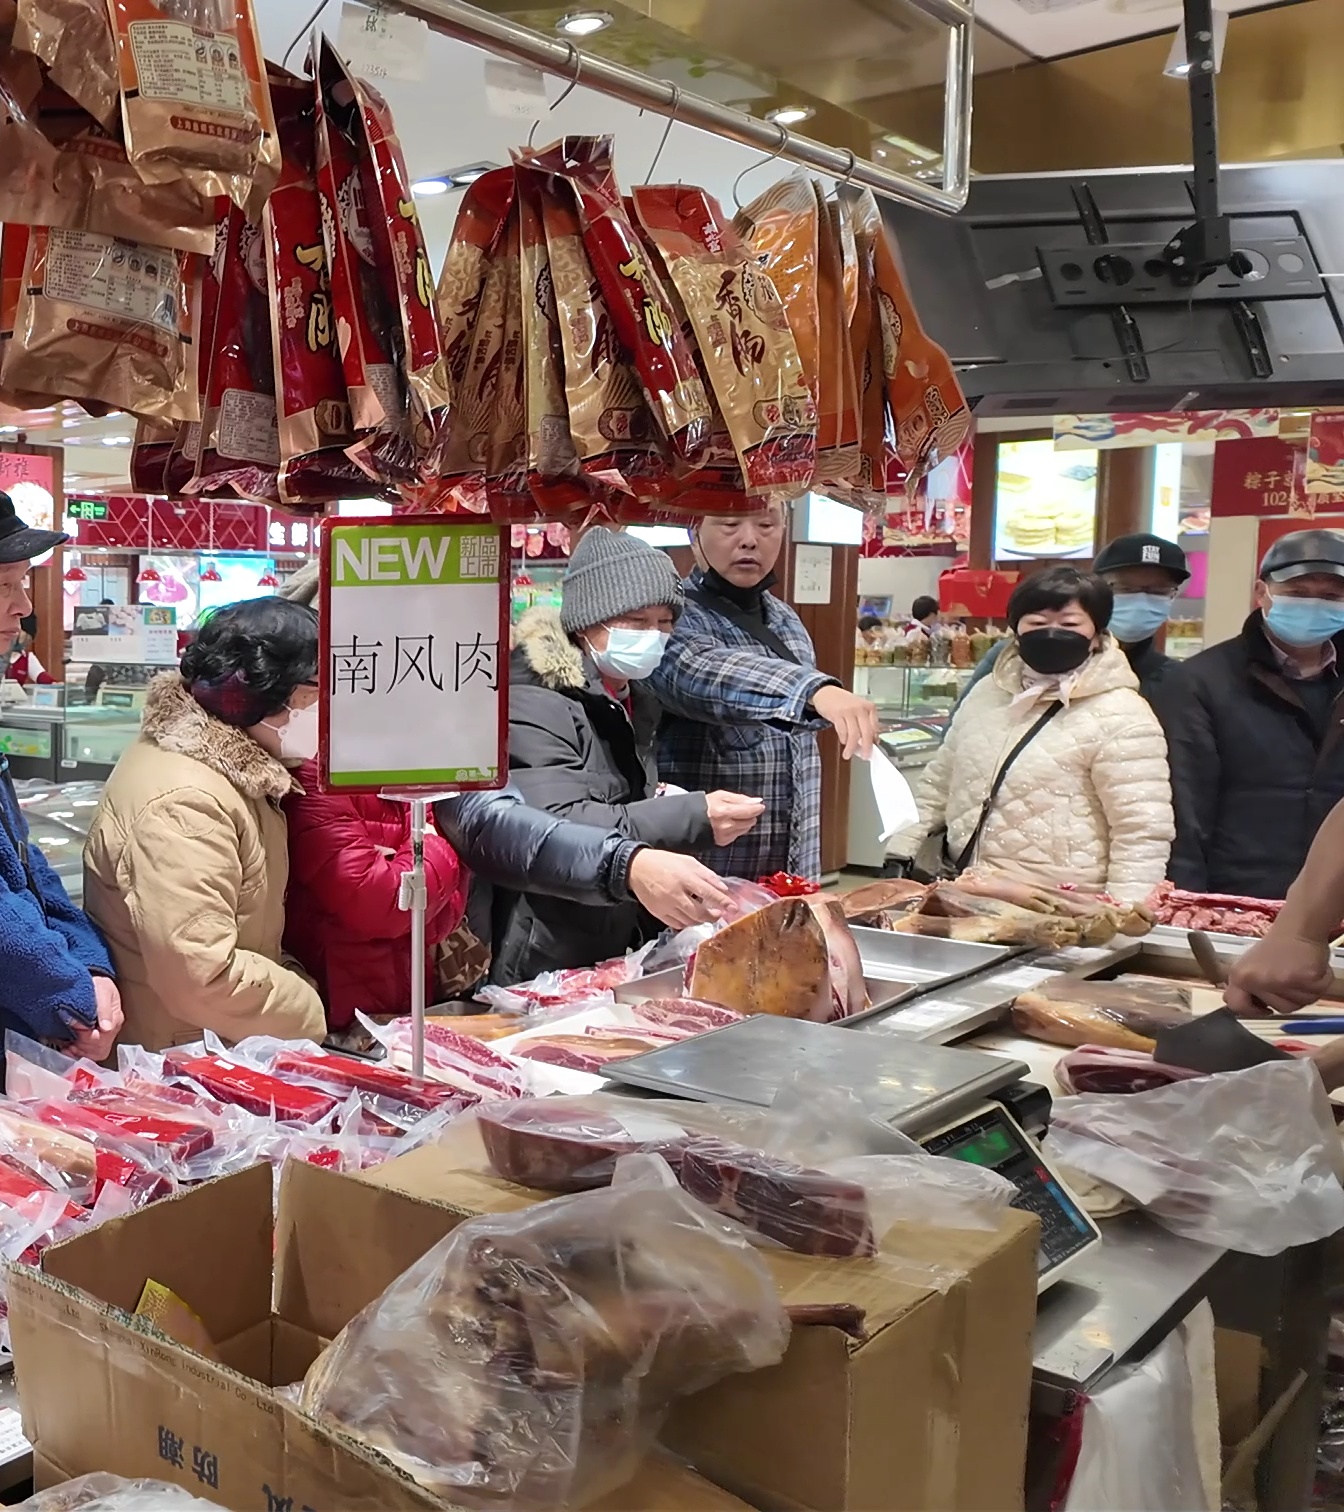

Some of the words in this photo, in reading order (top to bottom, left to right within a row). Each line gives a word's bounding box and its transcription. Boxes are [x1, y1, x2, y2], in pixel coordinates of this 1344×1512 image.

[714, 269, 765, 377] 香肠
[269, 521, 321, 547] 生鲜
[460, 536, 498, 556] 新品
[335, 536, 452, 582] NEW
[460, 557, 499, 578] 上市
[330, 632, 500, 696] 南风肉
[182, 1360, 231, 1393] Industrial
[158, 1424, 220, 1490] 防潮
